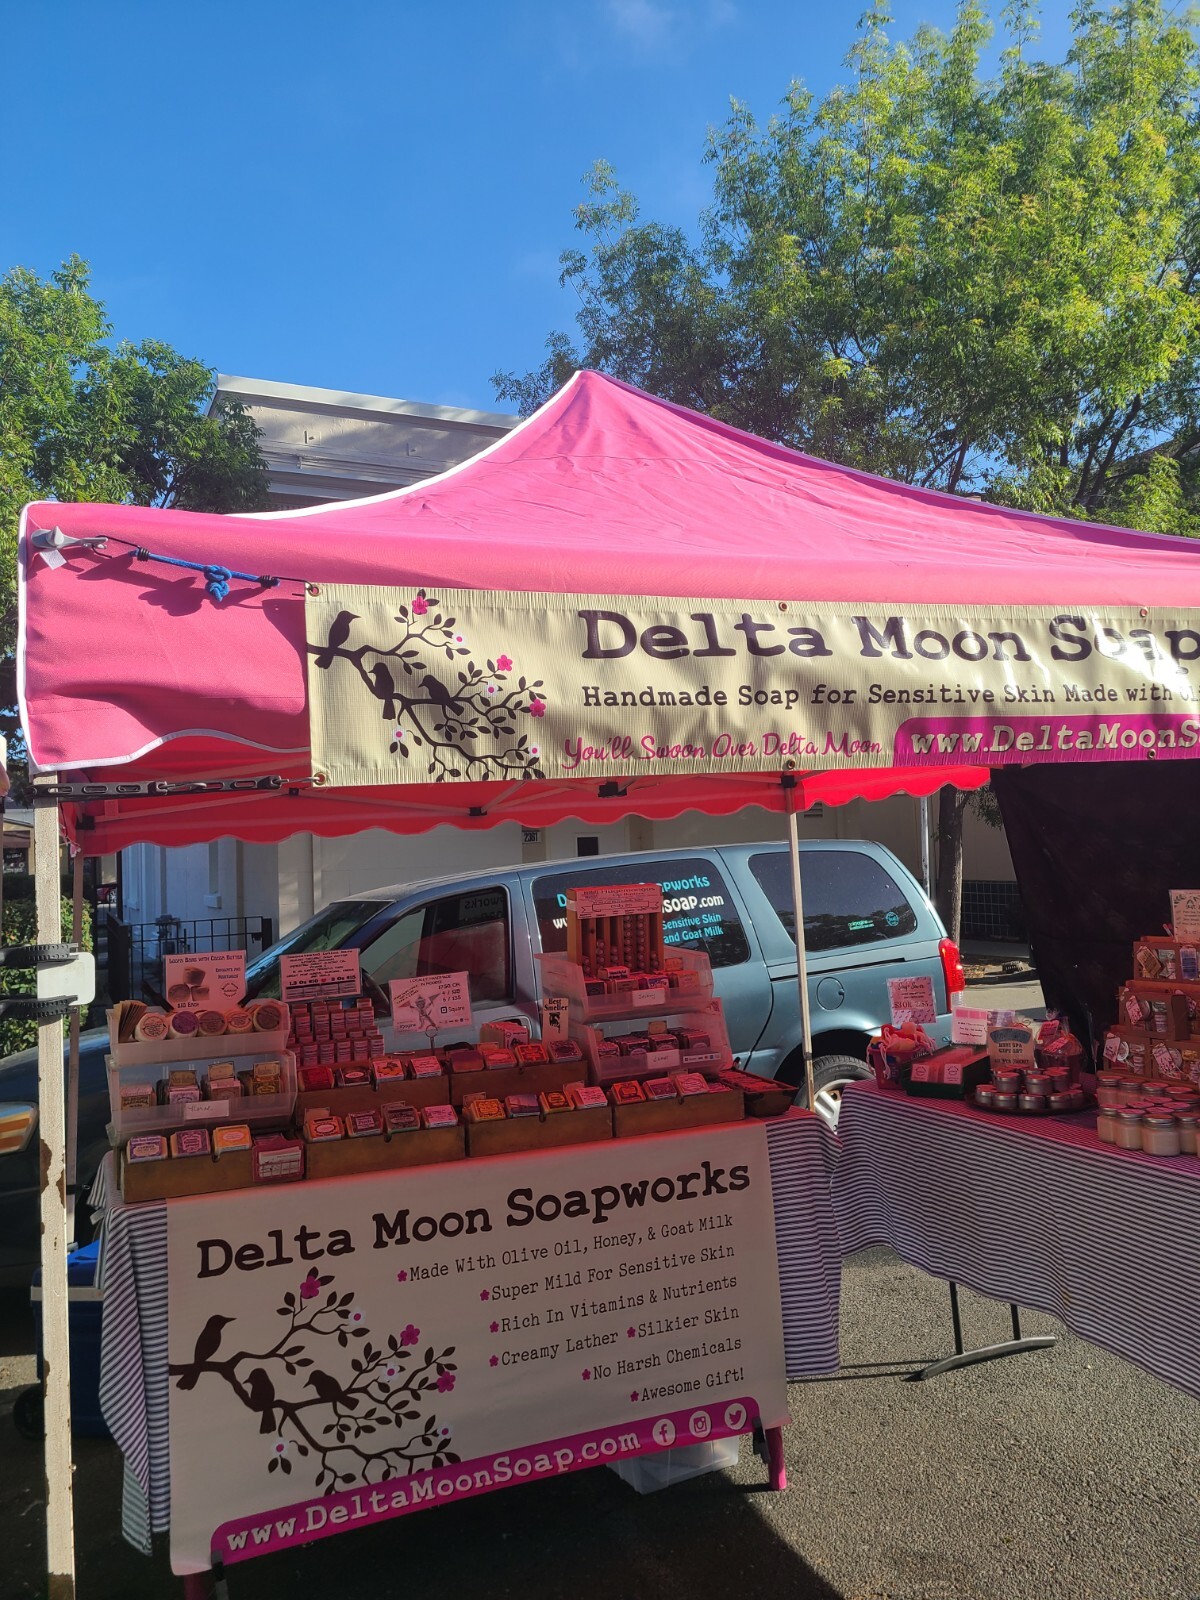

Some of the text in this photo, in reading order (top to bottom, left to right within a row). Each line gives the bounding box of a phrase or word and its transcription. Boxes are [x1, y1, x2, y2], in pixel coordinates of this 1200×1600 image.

[578, 609, 833, 660] Delta
[851, 615, 1032, 661] Moon
[582, 686, 728, 707] Handmade
[738, 685, 799, 709] Soap
[811, 684, 857, 704] for
[868, 684, 995, 704] Sensitive
[1004, 684, 1056, 703] Skin
[1063, 683, 1119, 702] Made
[1126, 682, 1174, 702] with
[561, 731, 882, 769] You'll Swoon Over Delta Moon
[911, 719, 1200, 753] www.DeltaMoonS
[663, 925, 725, 944] and Goat Milk
[702, 912, 723, 924] Skin
[197, 1161, 750, 1278] Delta Moon Soapworks
[410, 1214, 733, 1282] Made With Olive Oil, Honey, & Goat Milk
[491, 1244, 736, 1301] Super Mild For Sensitive Skin
[501, 1275, 738, 1333] Rich In Vitamins & Nutrients
[501, 1305, 740, 1366] Creamy Lather Silkier Skin
[593, 1338, 742, 1380] No Harsh Chemicals
[641, 1366, 745, 1402] Awesome Gift!
[226, 1428, 641, 1551] www.DeltaMoonSoap.com
